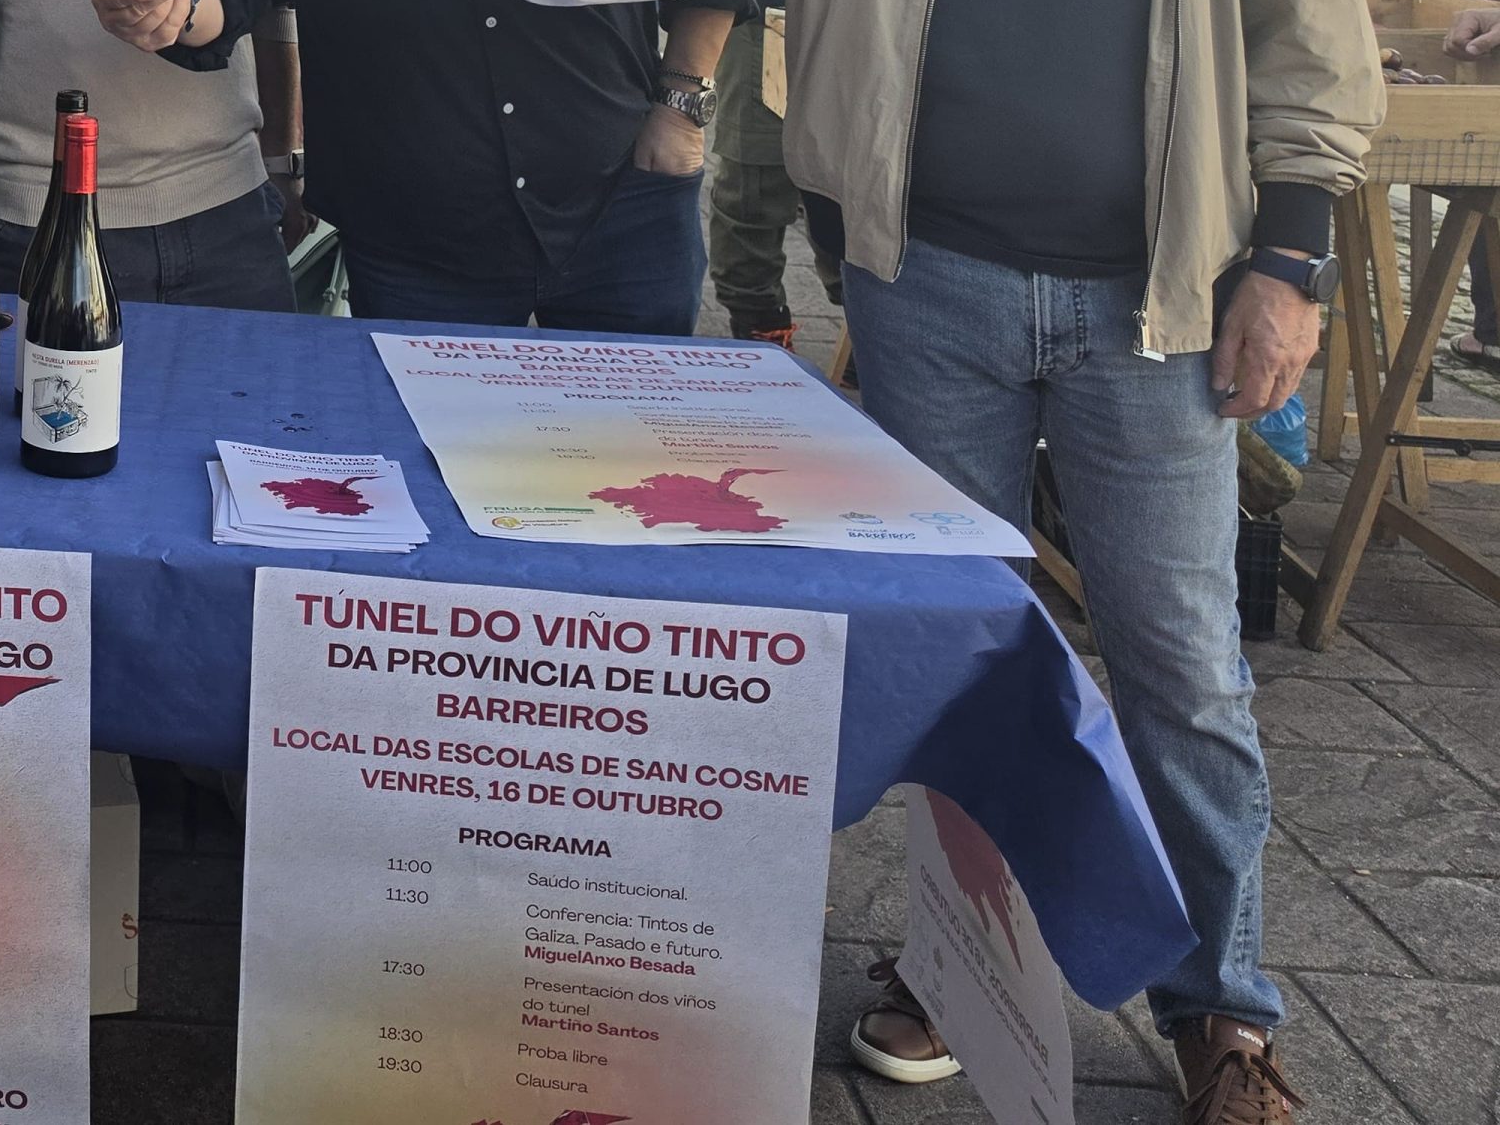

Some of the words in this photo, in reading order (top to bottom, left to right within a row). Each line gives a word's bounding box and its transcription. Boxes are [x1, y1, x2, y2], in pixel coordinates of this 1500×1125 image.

[475, 353, 625, 365] PROVINCIA
[673, 361, 751, 369] LUGO
[513, 345, 563, 353] DO
[660, 350, 762, 361] TINTO
[520, 364, 676, 375] BARREIROS
[563, 393, 684, 402] PROGRAMA
[295, 589, 438, 636] TÚNEL
[450, 607, 520, 643] DO
[532, 611, 651, 654] VIÑO
[663, 624, 806, 666] TINTO
[327, 643, 378, 671] DA
[387, 648, 595, 689] PROVINCIA
[605, 666, 654, 694] DE
[663, 671, 771, 704] LUGO
[436, 694, 649, 735] BARREIROS
[272, 728, 365, 755] LOCAL
[373, 736, 431, 761] DAS
[438, 742, 575, 775] ESCOLAS
[581, 755, 620, 778] DE
[626, 758, 687, 785] SAN
[694, 765, 809, 797] COSME
[360, 768, 481, 803] VENRES,
[487, 781, 521, 803] 16
[527, 784, 566, 806] DE
[572, 787, 723, 821] OUTUBRO
[458, 827, 612, 859] PROGRAMA
[386, 857, 432, 875] 11:00
[386, 888, 429, 905] 11:30
[527, 872, 580, 893] Saúdo
[584, 877, 689, 902] institucional.
[526, 904, 633, 928] Conferencia:
[637, 915, 688, 934] Tintos
[693, 920, 715, 936] de
[524, 927, 579, 947] Galiza.
[584, 933, 645, 952] Pasado
[650, 943, 660, 953] e
[665, 940, 723, 960] futuro.
[382, 960, 425, 976] 17:30
[524, 946, 626, 970] MiguelAnxo
[630, 955, 696, 976] Besada
[522, 997, 544, 1012] do
[547, 997, 590, 1017] túnel
[523, 978, 634, 1001] Presentación
[637, 988, 669, 1005] dos
[673, 992, 717, 1011] viños
[378, 1026, 423, 1044] 18:30
[521, 1014, 593, 1034] Martiño
[597, 1021, 660, 1041] Santos
[377, 1056, 422, 1074] 19:30
[516, 1043, 568, 1064] Proba
[572, 1047, 608, 1066] libre
[515, 1073, 588, 1094] Clausura
